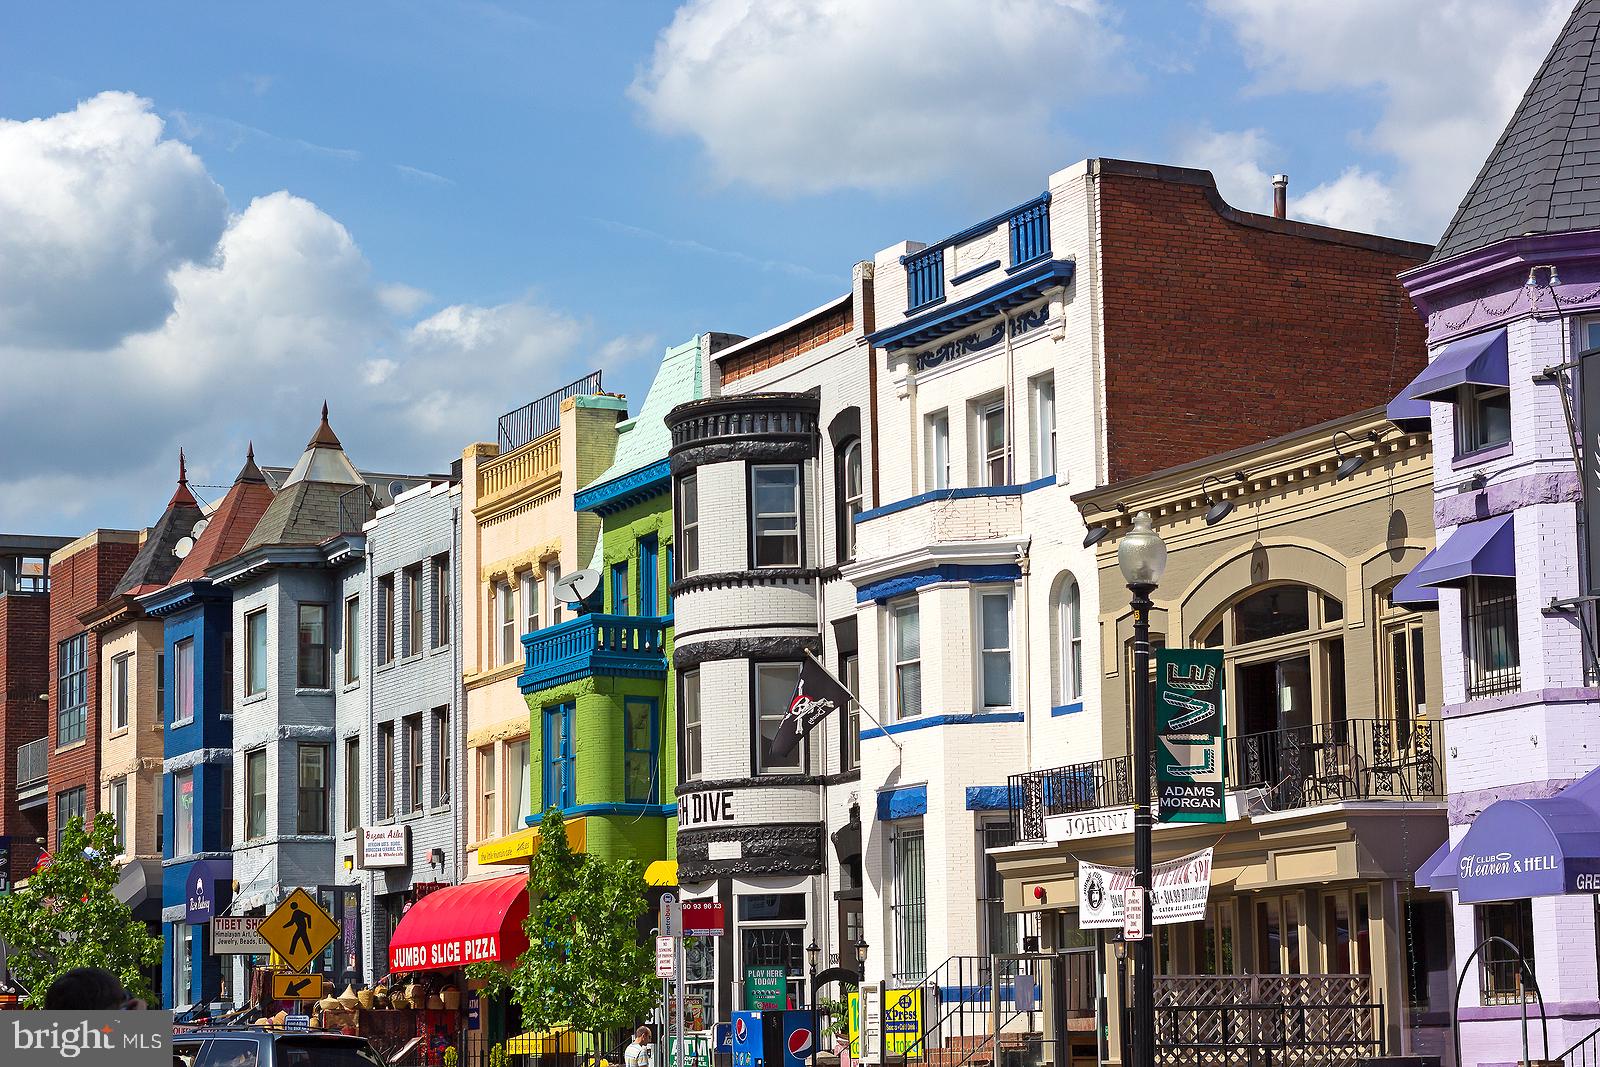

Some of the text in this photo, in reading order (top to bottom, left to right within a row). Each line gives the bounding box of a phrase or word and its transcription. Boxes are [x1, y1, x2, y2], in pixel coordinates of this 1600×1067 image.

[1163, 662, 1216, 777] LIVE
[1164, 786, 1215, 797] ADAMS
[692, 791, 735, 824] DIVE
[1159, 797, 1221, 809] MORGAN
[1065, 812, 1128, 837] JOHNNY
[1476, 855, 1496, 864] CLUB
[1460, 854, 1558, 879] Heaven & HELL
[216, 919, 242, 930] TIBET
[215, 931, 241, 939] Himalayan
[393, 936, 497, 968] JUMBO SLICE PIZZA
[748, 969, 783, 978] PLAY HERE
[753, 977, 777, 986] TODAY!
[671, 1039, 708, 1057] ATM
